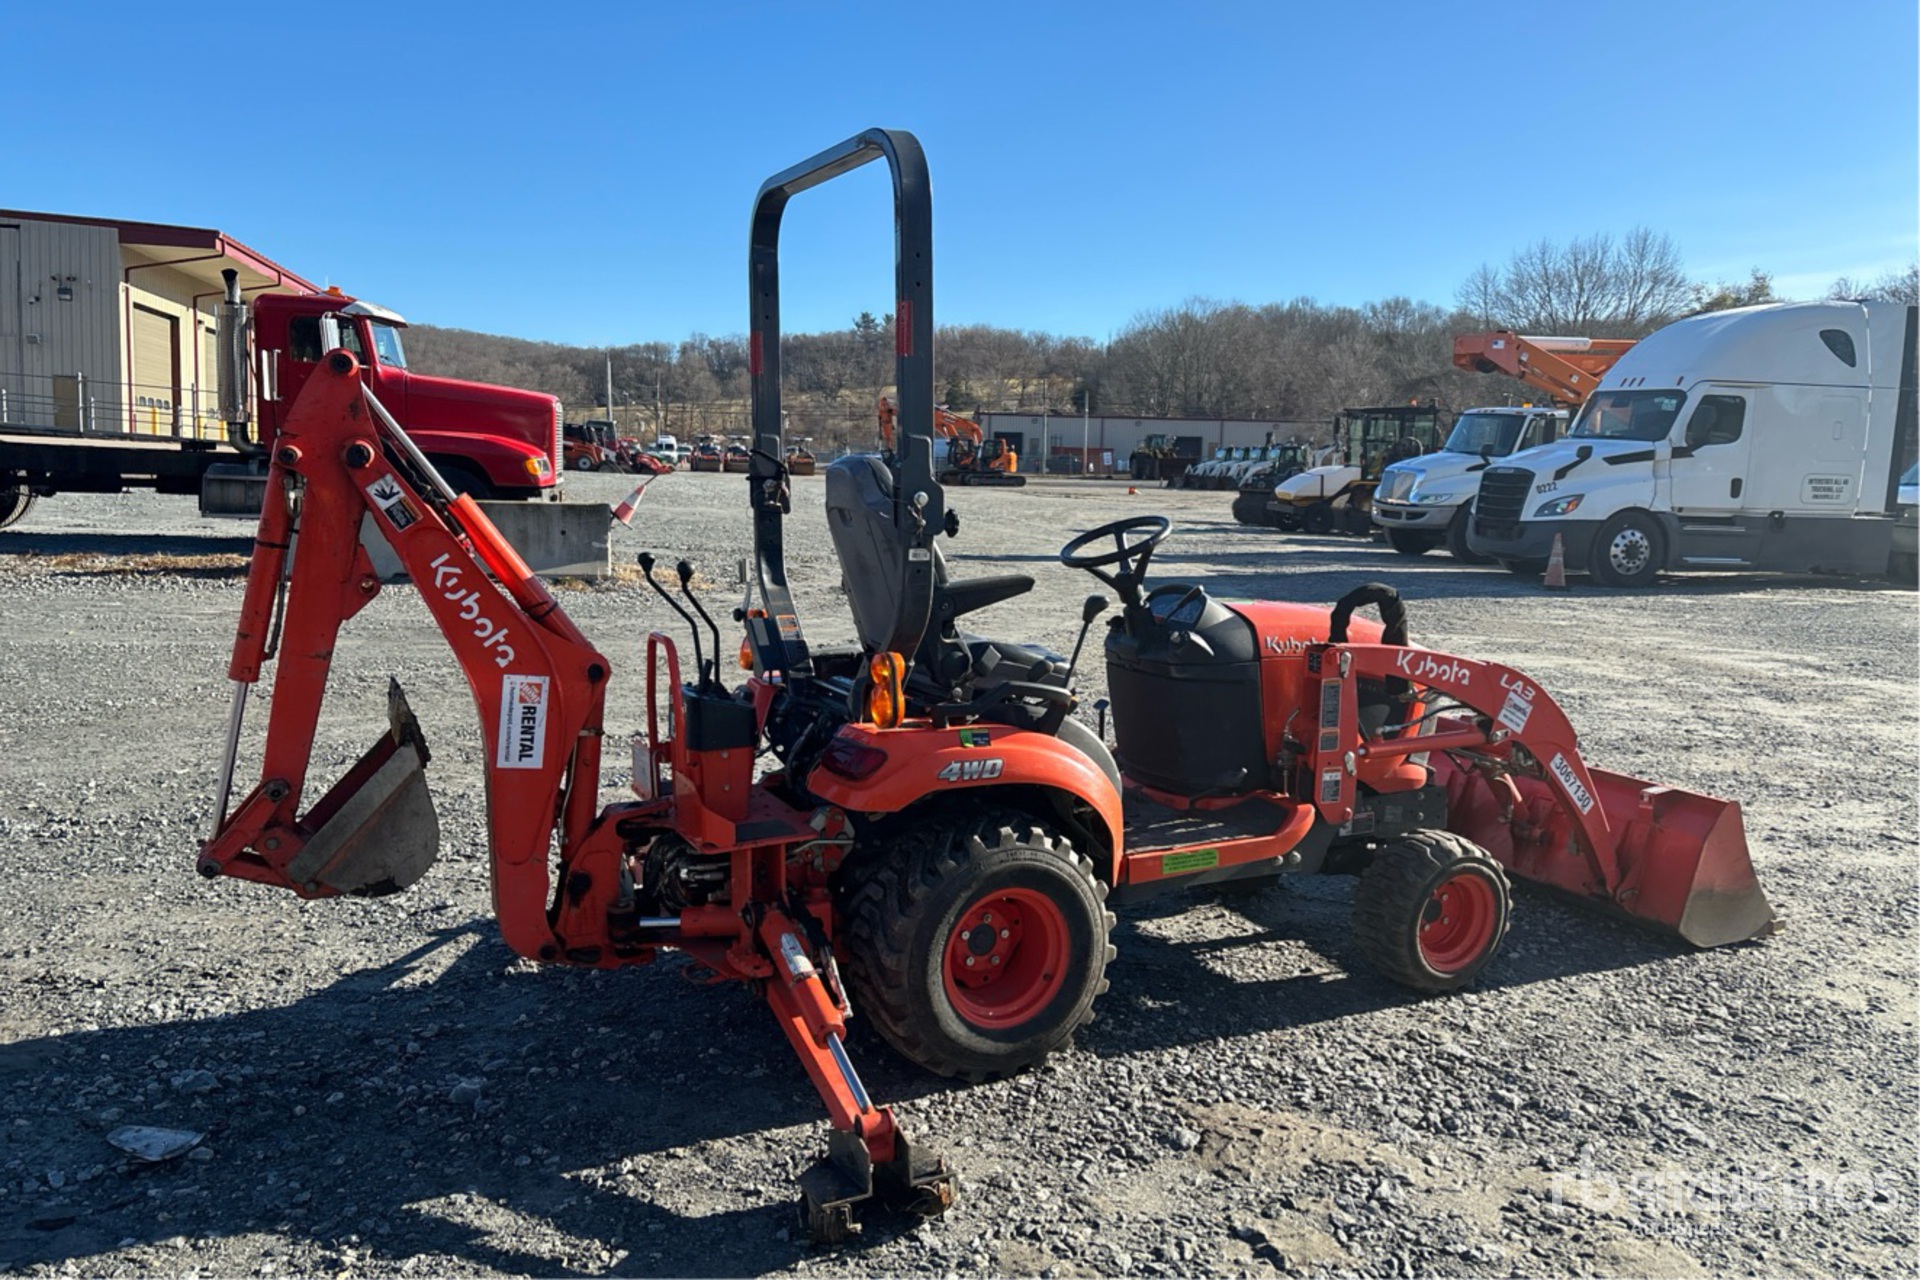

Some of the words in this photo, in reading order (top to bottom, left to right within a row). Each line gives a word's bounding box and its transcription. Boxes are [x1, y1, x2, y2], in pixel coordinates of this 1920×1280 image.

[429, 552, 515, 668] Kubota
[1396, 649, 1470, 686] Kubota
[518, 705, 537, 762] RENTAL
[937, 758, 1004, 782] 4WD
[1554, 756, 1592, 809] 3067130
